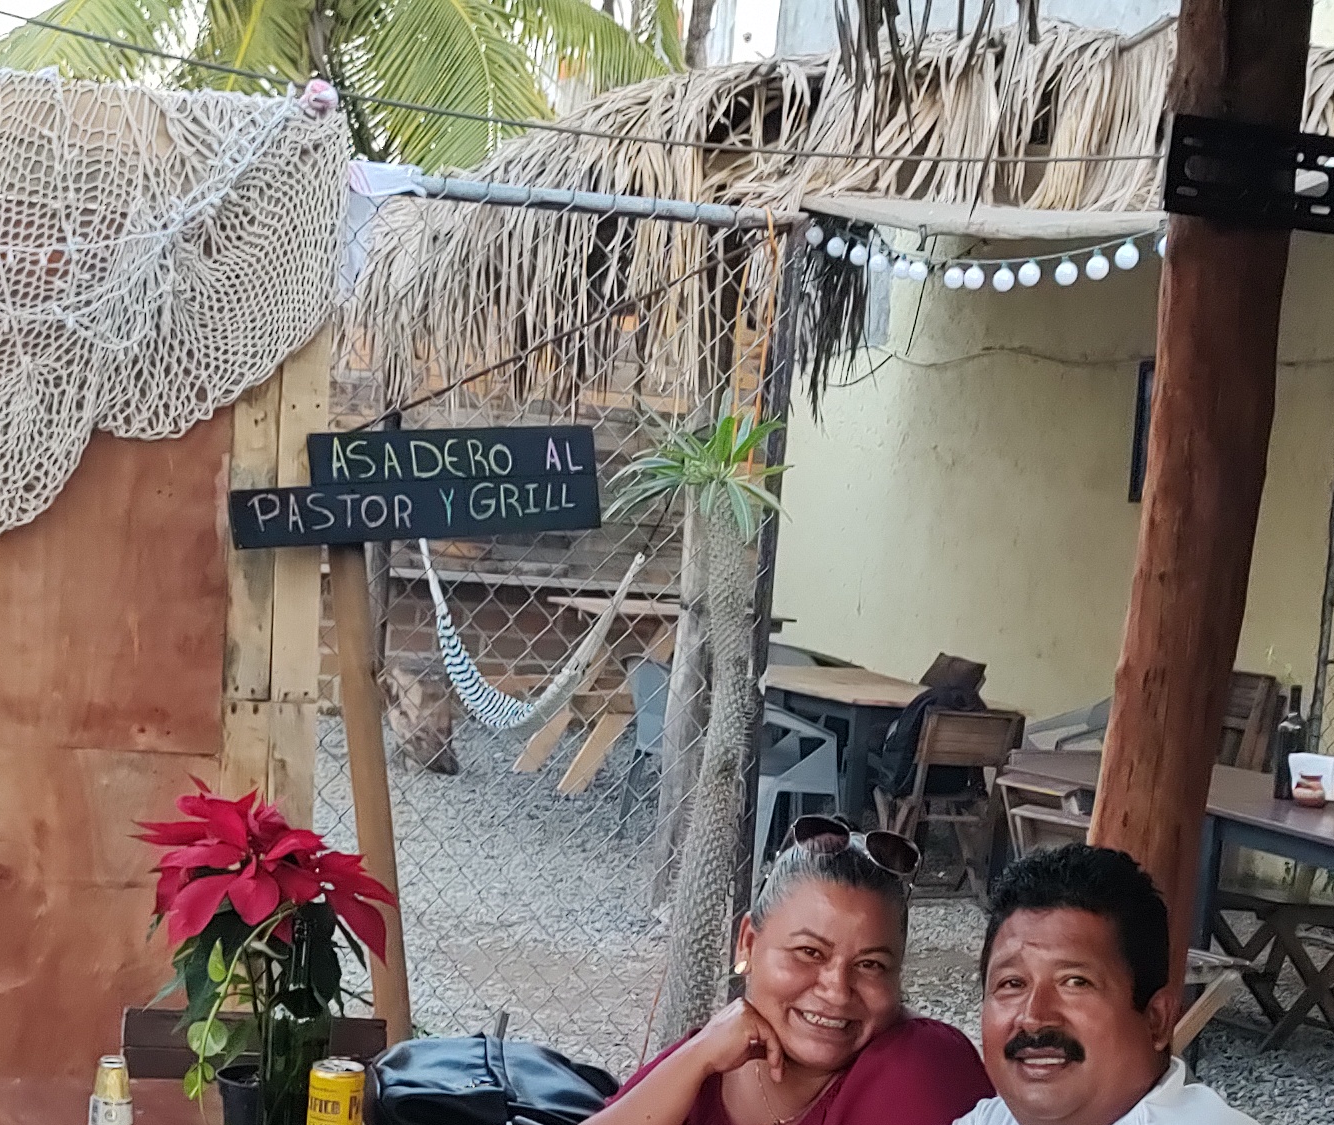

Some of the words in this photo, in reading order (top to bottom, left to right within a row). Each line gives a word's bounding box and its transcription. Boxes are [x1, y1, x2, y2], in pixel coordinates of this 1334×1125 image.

[331, 437, 513, 480] ASADERO
[546, 437, 583, 474] AL
[248, 492, 413, 534] PASTOR
[439, 488, 455, 527] Y
[469, 482, 575, 521] GRILL
